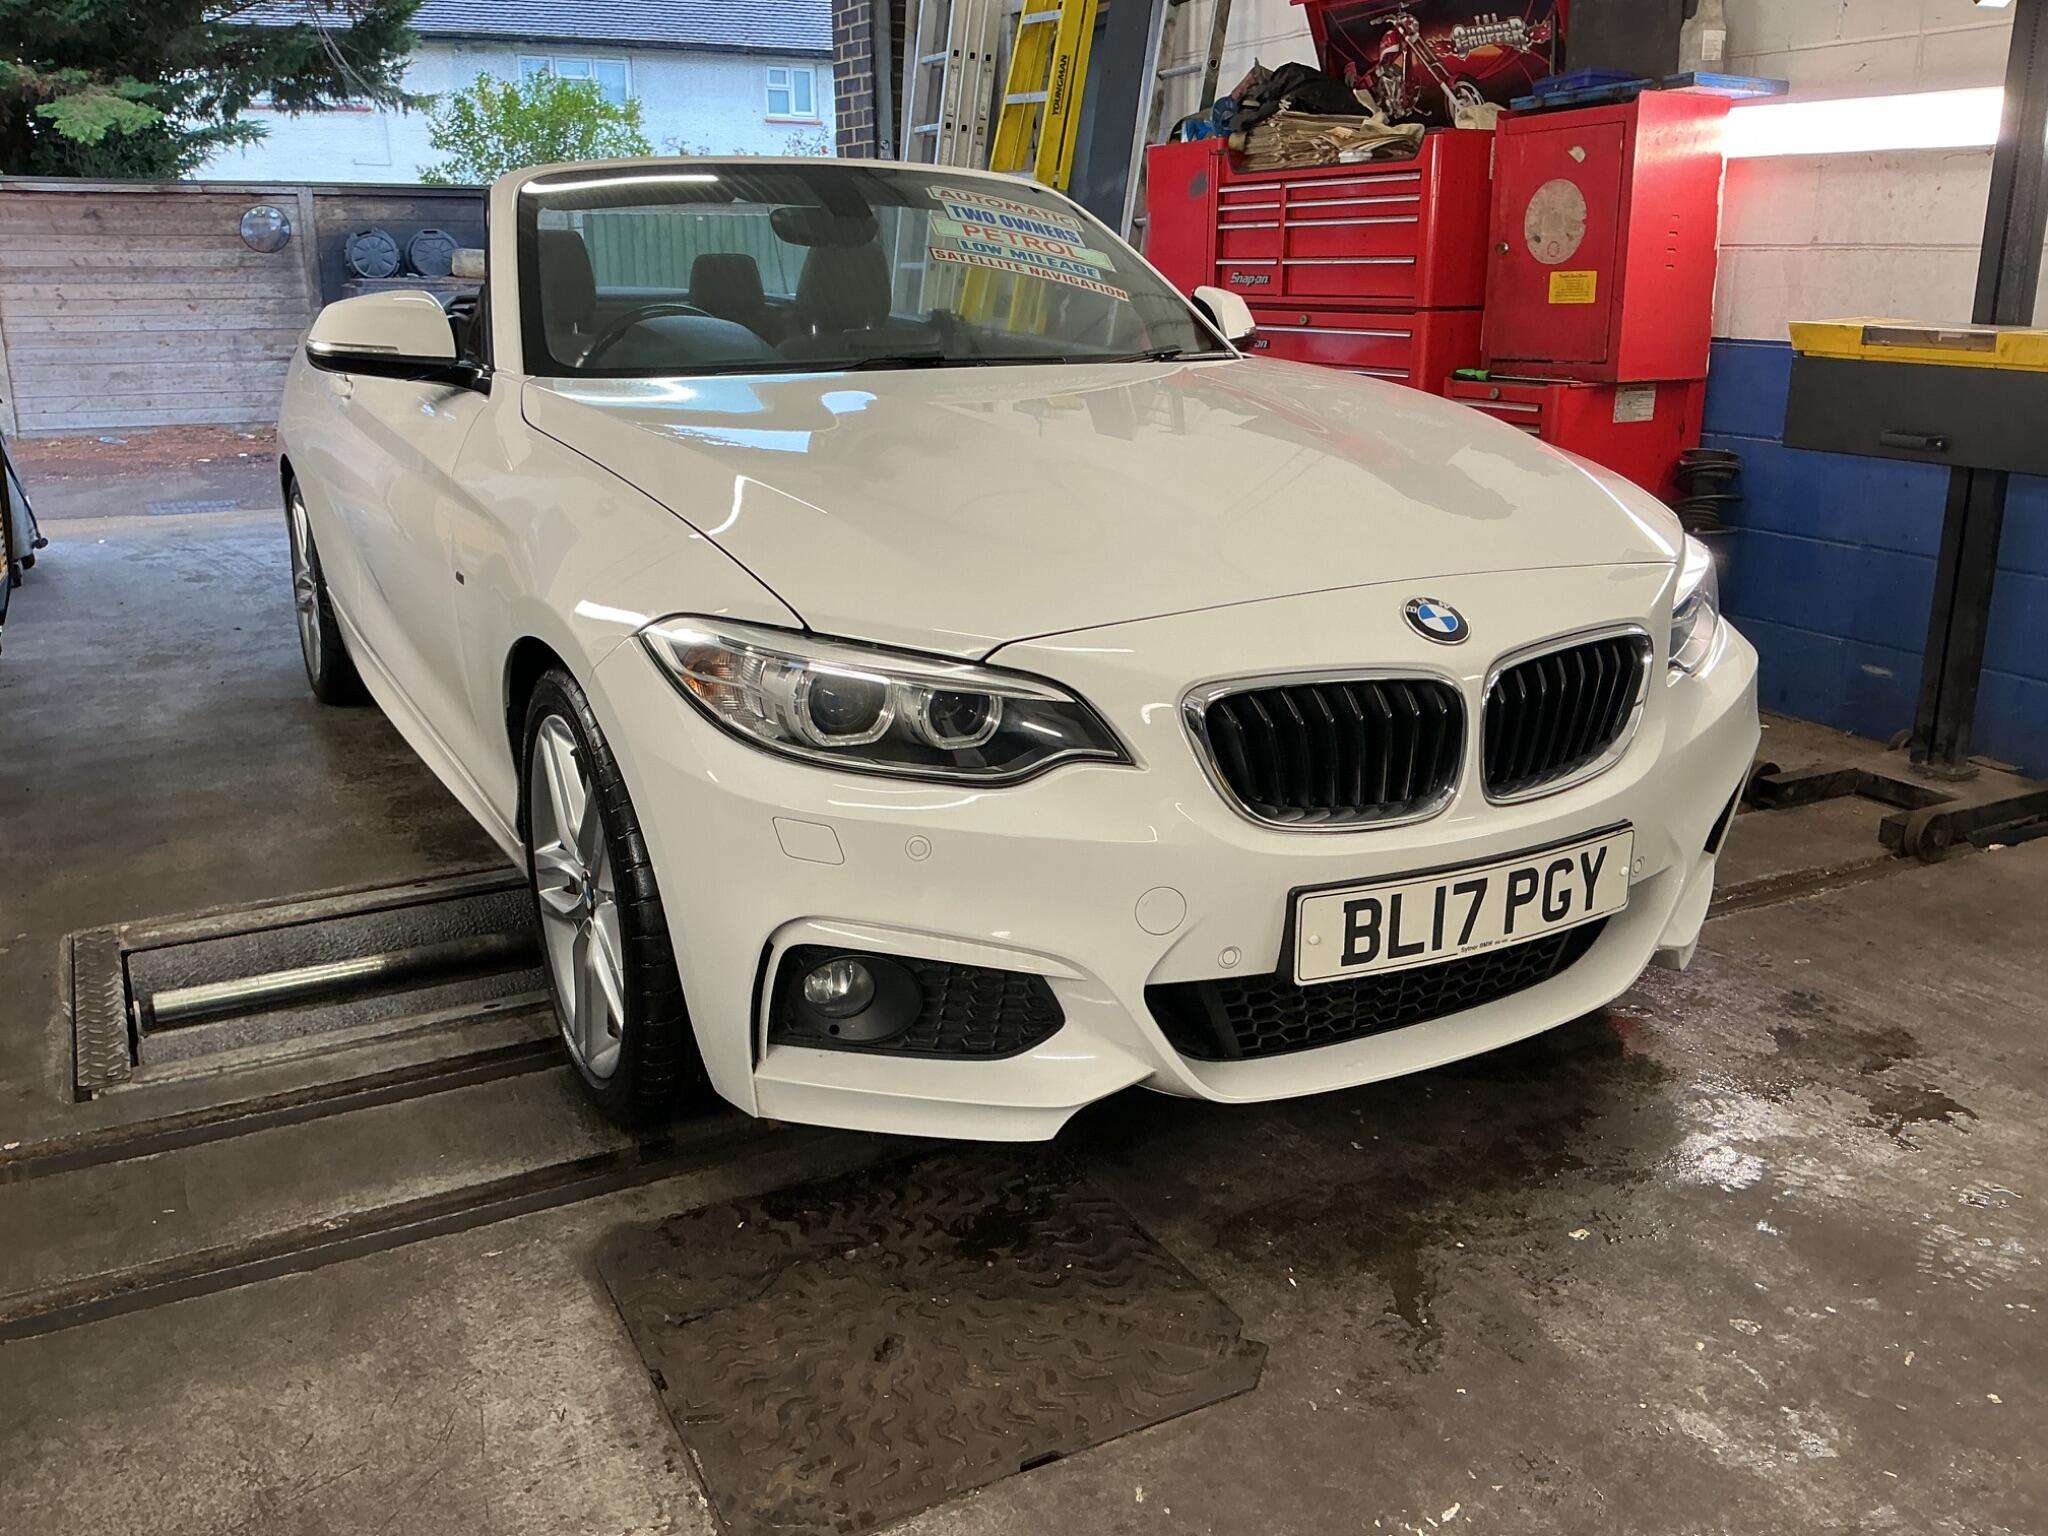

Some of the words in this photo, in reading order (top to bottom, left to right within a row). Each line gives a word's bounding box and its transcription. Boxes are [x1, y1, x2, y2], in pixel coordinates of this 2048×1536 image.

[1453, 18, 1529, 57] CHOPPER
[1052, 54, 1067, 115] YOUNGMAN
[939, 187, 1072, 226] AUTOMATIC
[948, 204, 996, 225] TWO
[999, 214, 1081, 244] OWNERS
[961, 224, 1085, 260] PETROL
[961, 240, 1003, 256] LOW
[1010, 250, 1100, 279] MILEAGE
[936, 249, 1024, 273] SATELLITE
[1029, 266, 1127, 299] NAVIGATION
[1230, 272, 1269, 286] Snap-on
[1340, 877, 1488, 967] BL17
[1503, 846, 1608, 935] PGY
